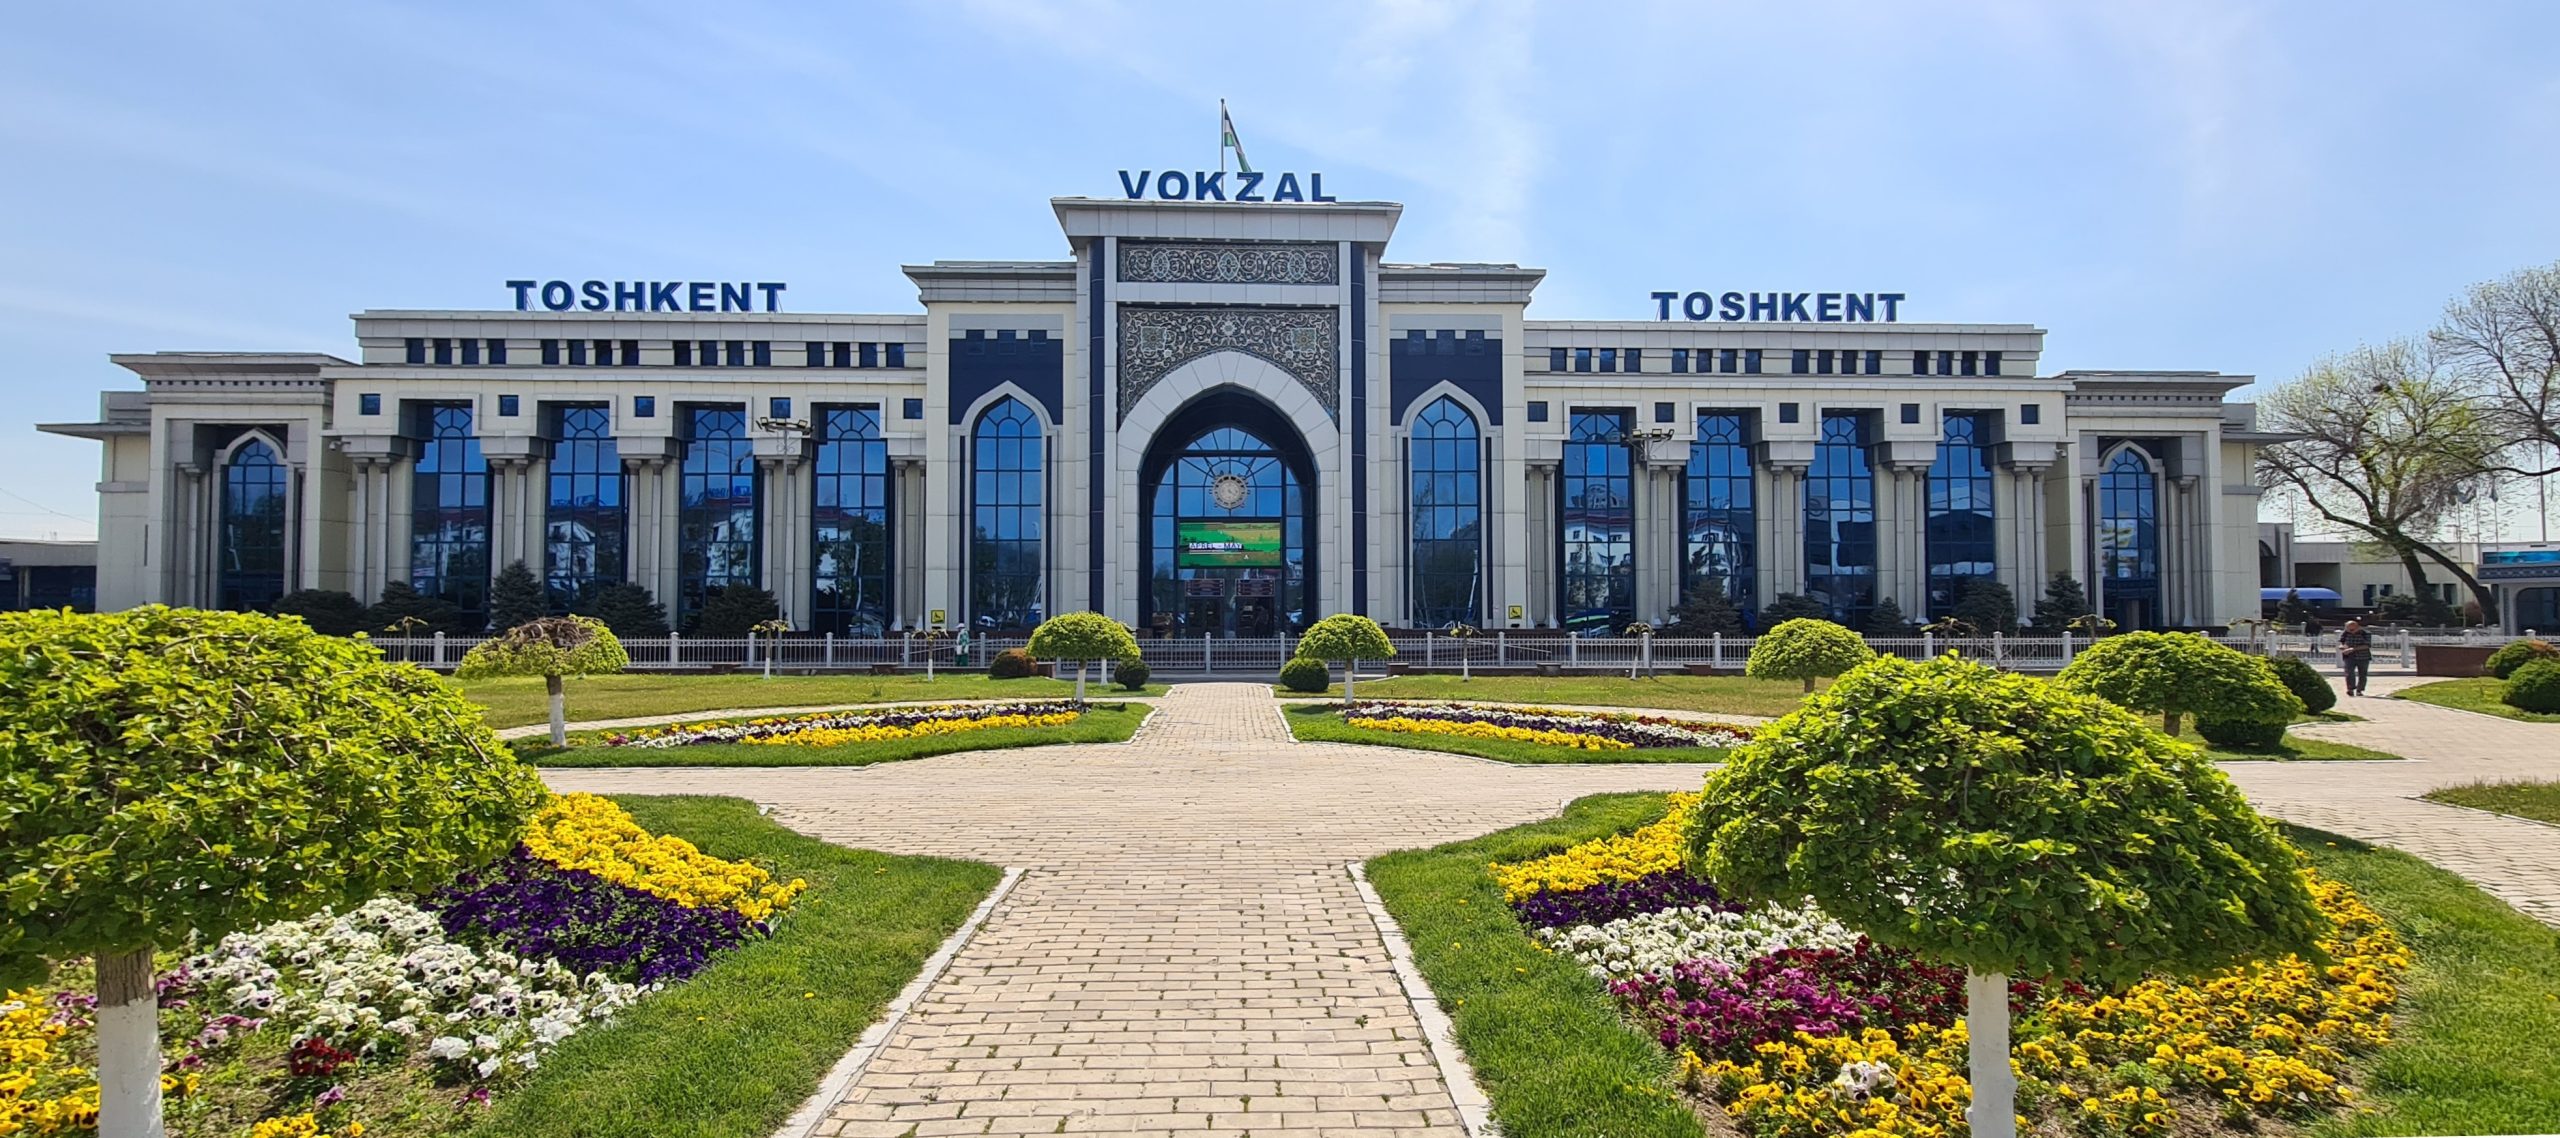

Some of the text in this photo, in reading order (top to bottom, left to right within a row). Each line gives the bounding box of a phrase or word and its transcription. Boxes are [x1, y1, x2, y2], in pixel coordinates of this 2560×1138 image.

[1118, 170, 1337, 202] VOKZAL
[505, 279, 787, 312] TOSHKENT
[1650, 291, 1906, 322] TOSHKENT
[1224, 542, 1242, 550] MAY
